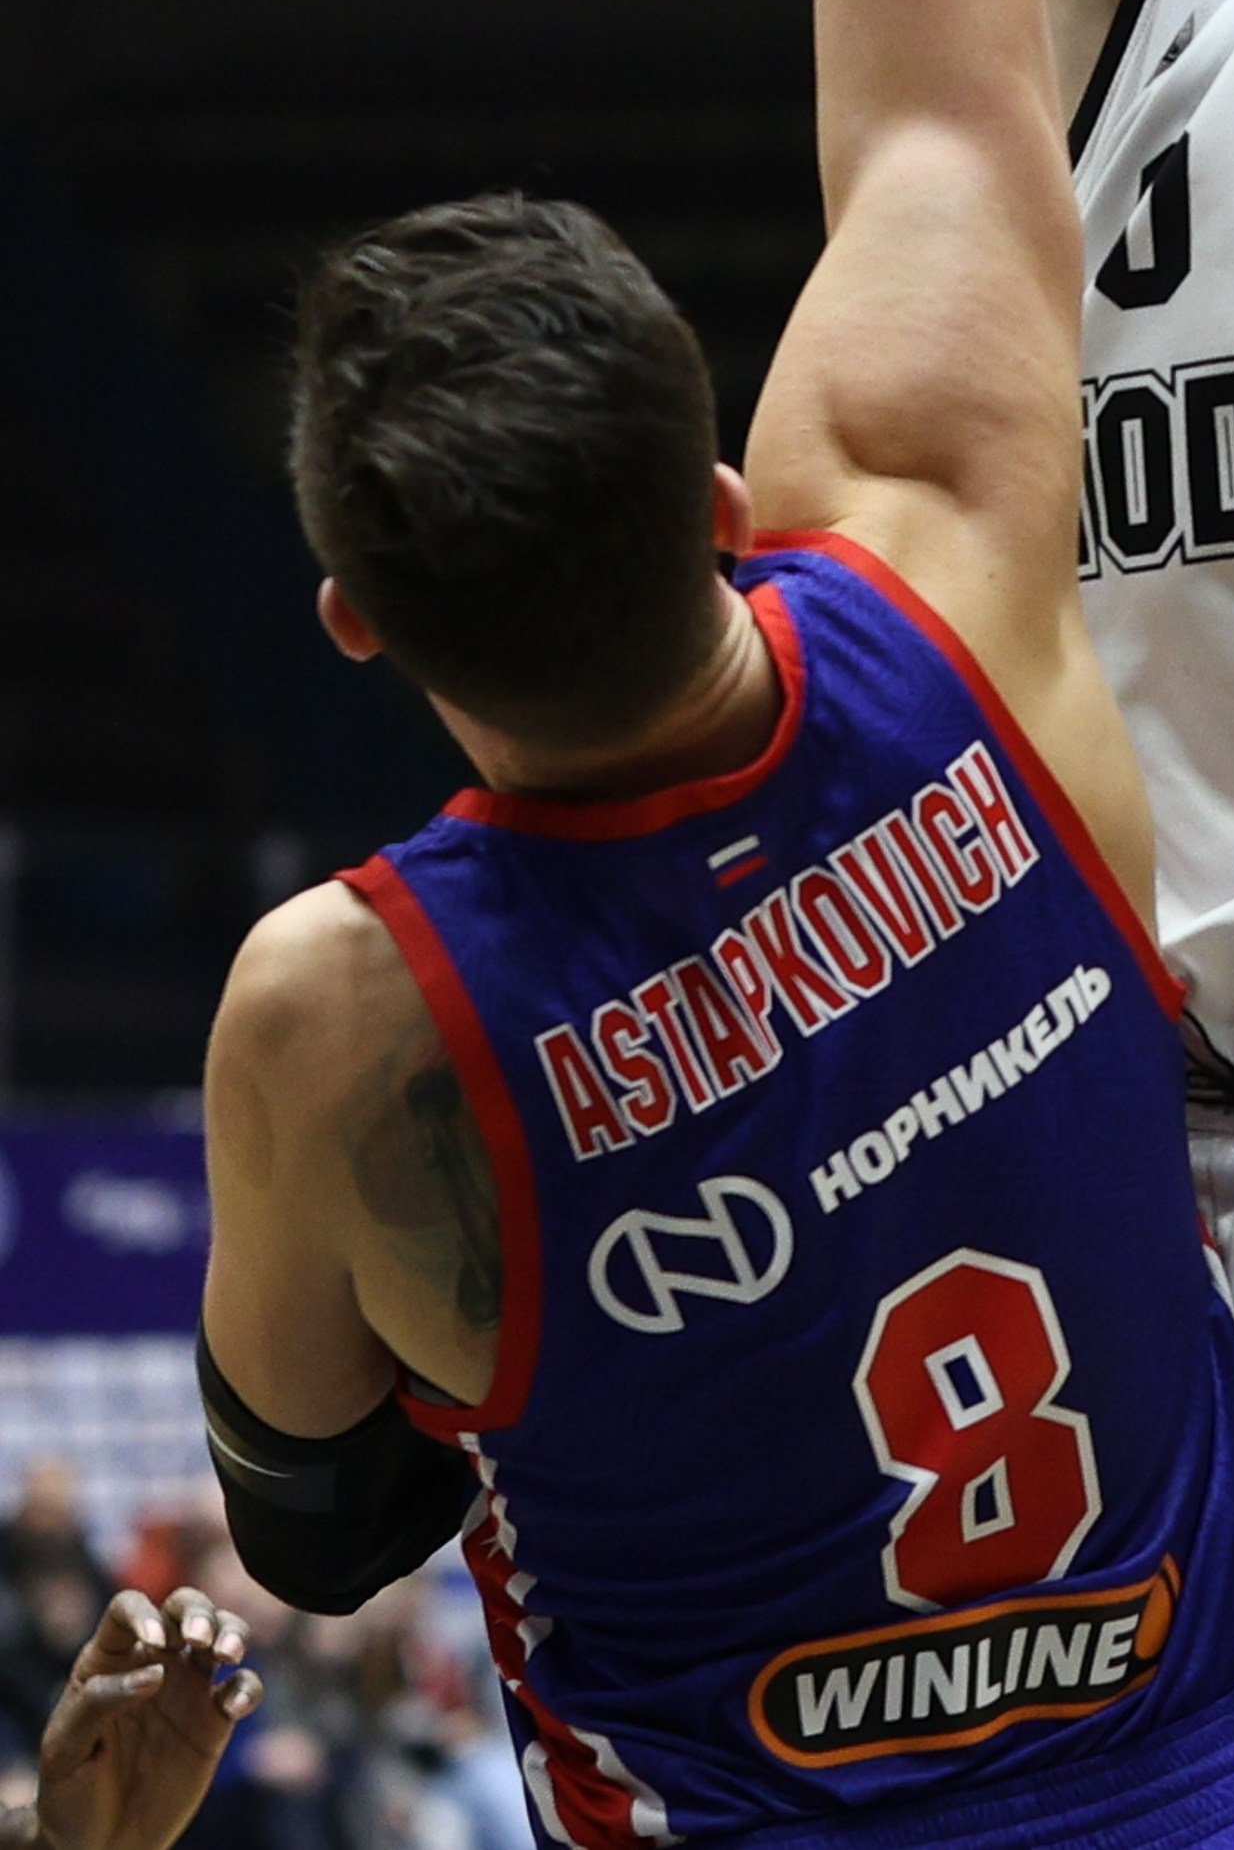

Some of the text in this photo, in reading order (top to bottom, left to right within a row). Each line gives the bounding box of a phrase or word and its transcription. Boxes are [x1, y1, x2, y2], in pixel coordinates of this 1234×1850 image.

[534, 739, 1040, 1162] ASTAPKOVICH
[809, 964, 1112, 1213] НОРНИКЕЛЬ
[852, 1247, 1103, 1614] 8
[796, 1614, 1140, 1728] WINLINE
